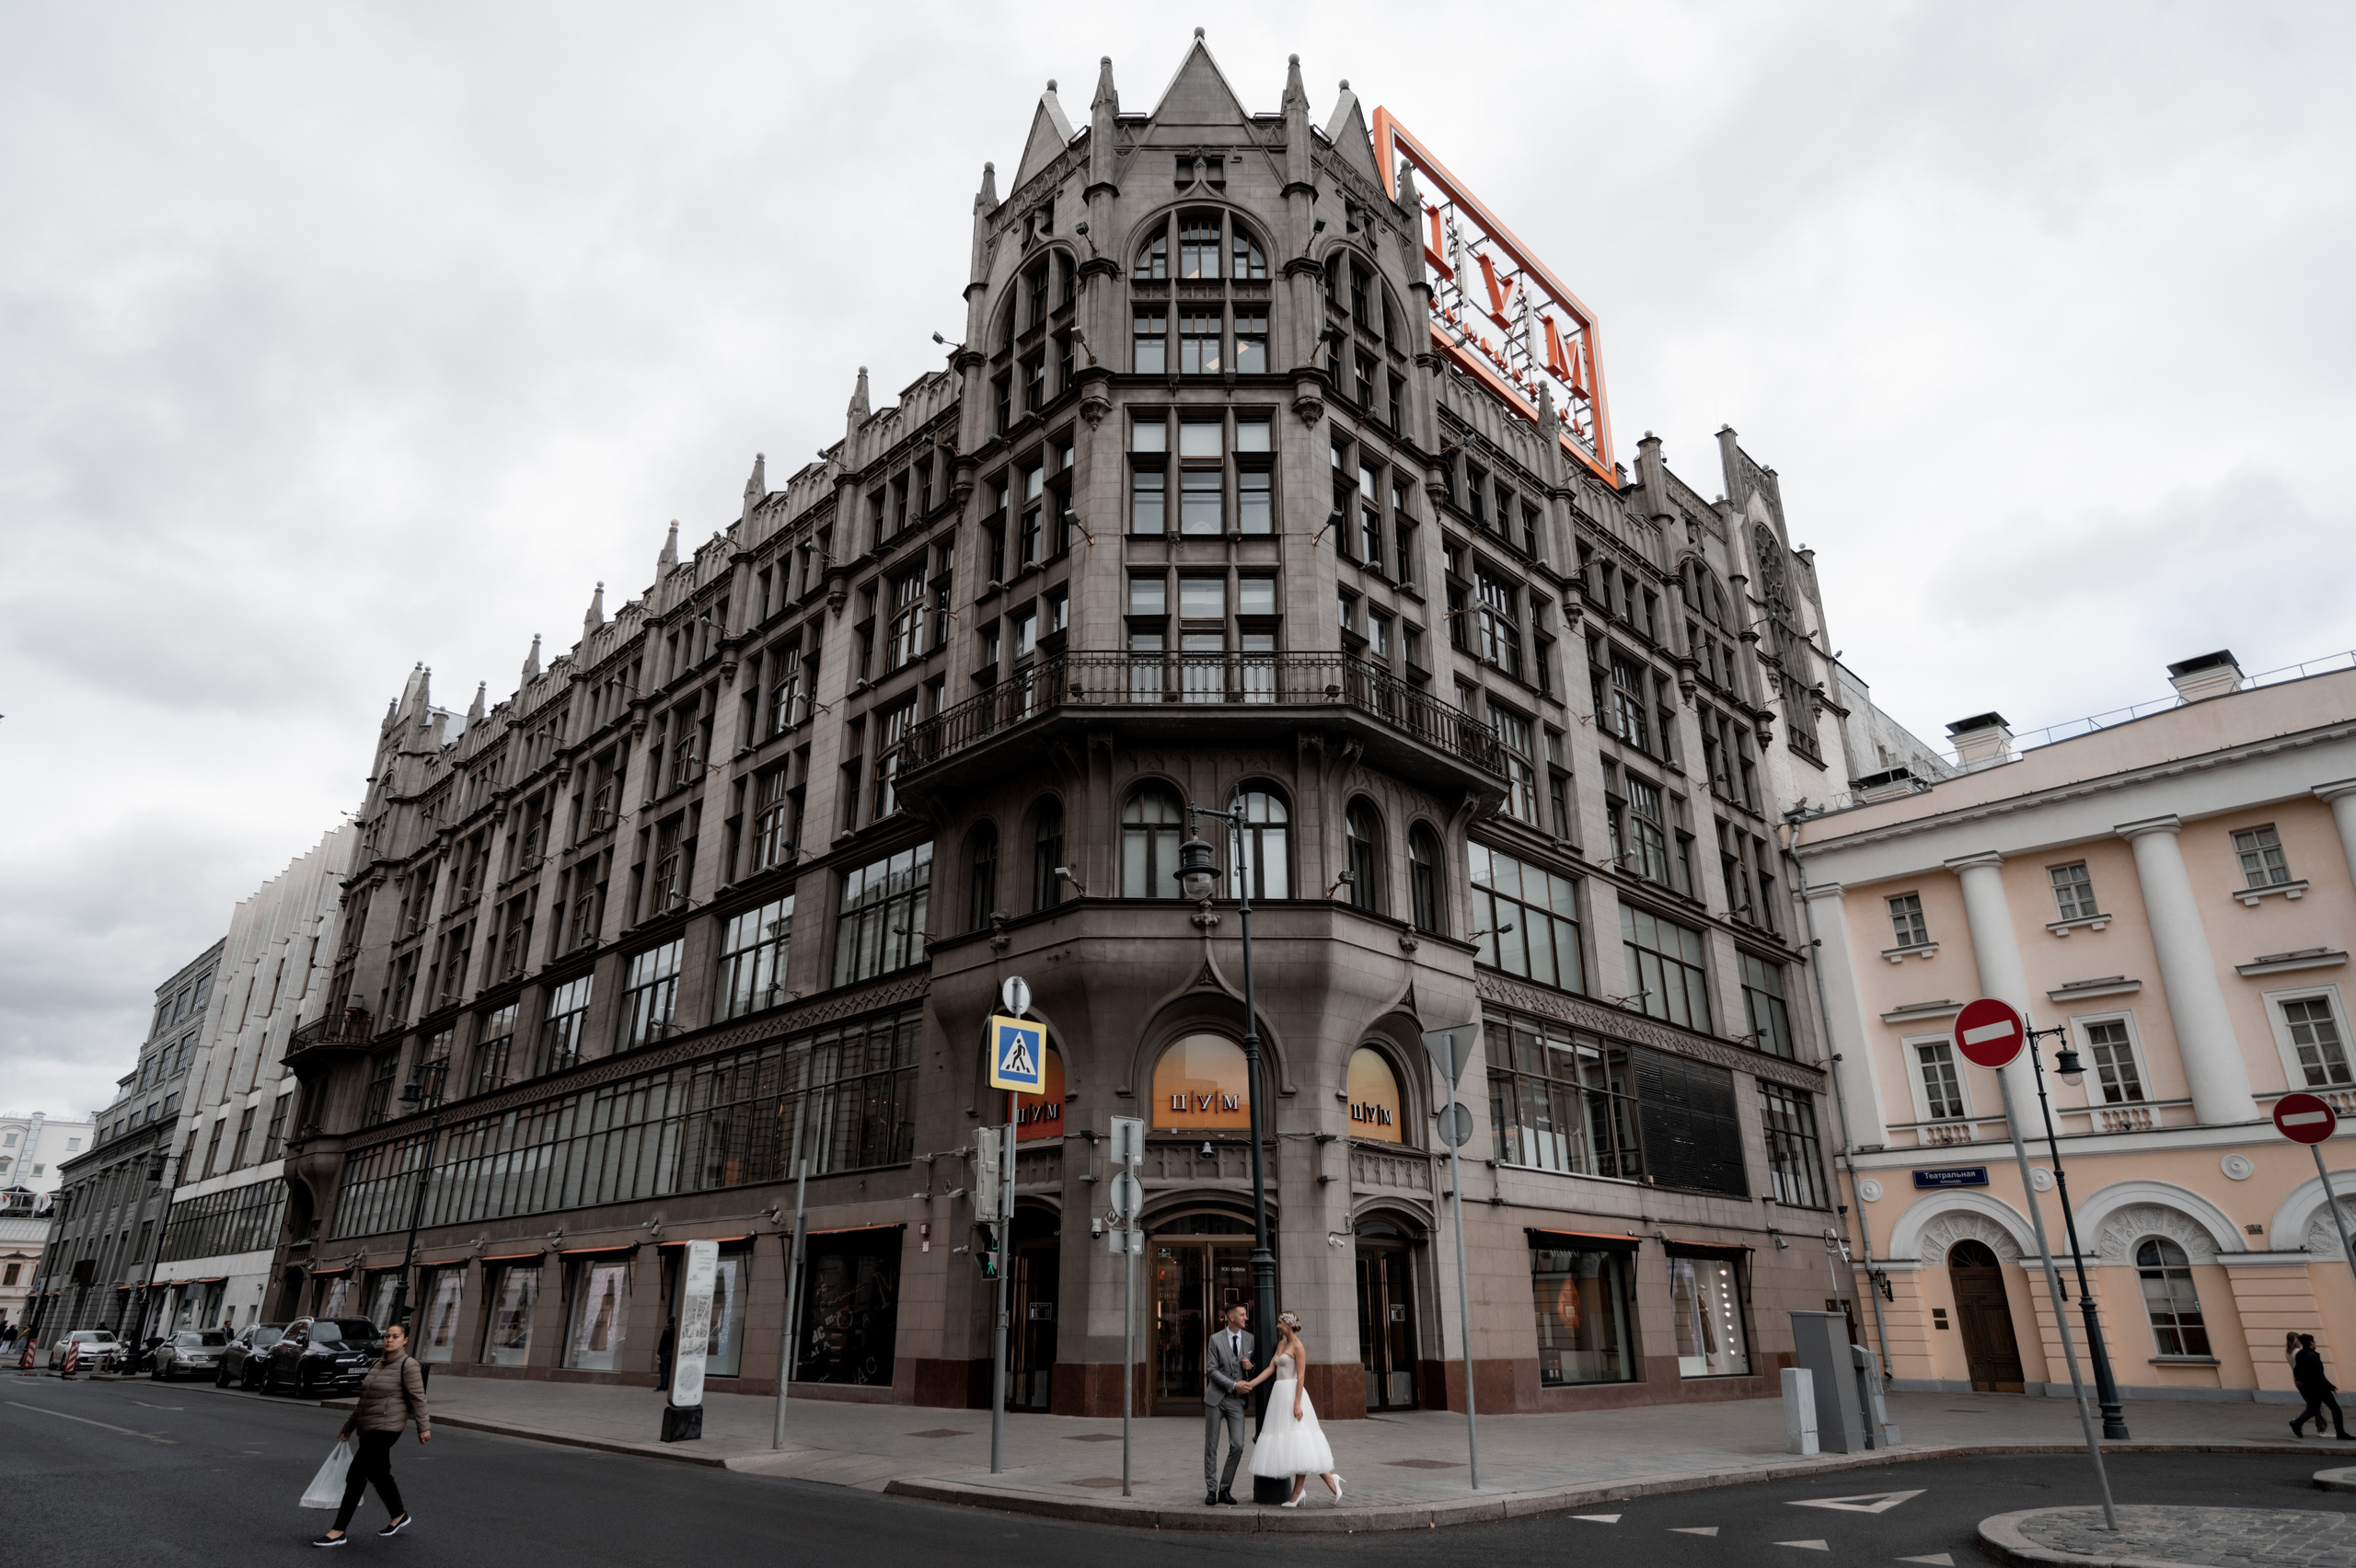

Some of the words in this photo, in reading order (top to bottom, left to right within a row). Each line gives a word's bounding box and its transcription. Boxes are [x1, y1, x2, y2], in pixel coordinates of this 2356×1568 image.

[1171, 1093, 1240, 1112] ЦУМ
[1351, 1103, 1392, 1124] ЦУМ
[1923, 1170, 1976, 1180] Театральная
